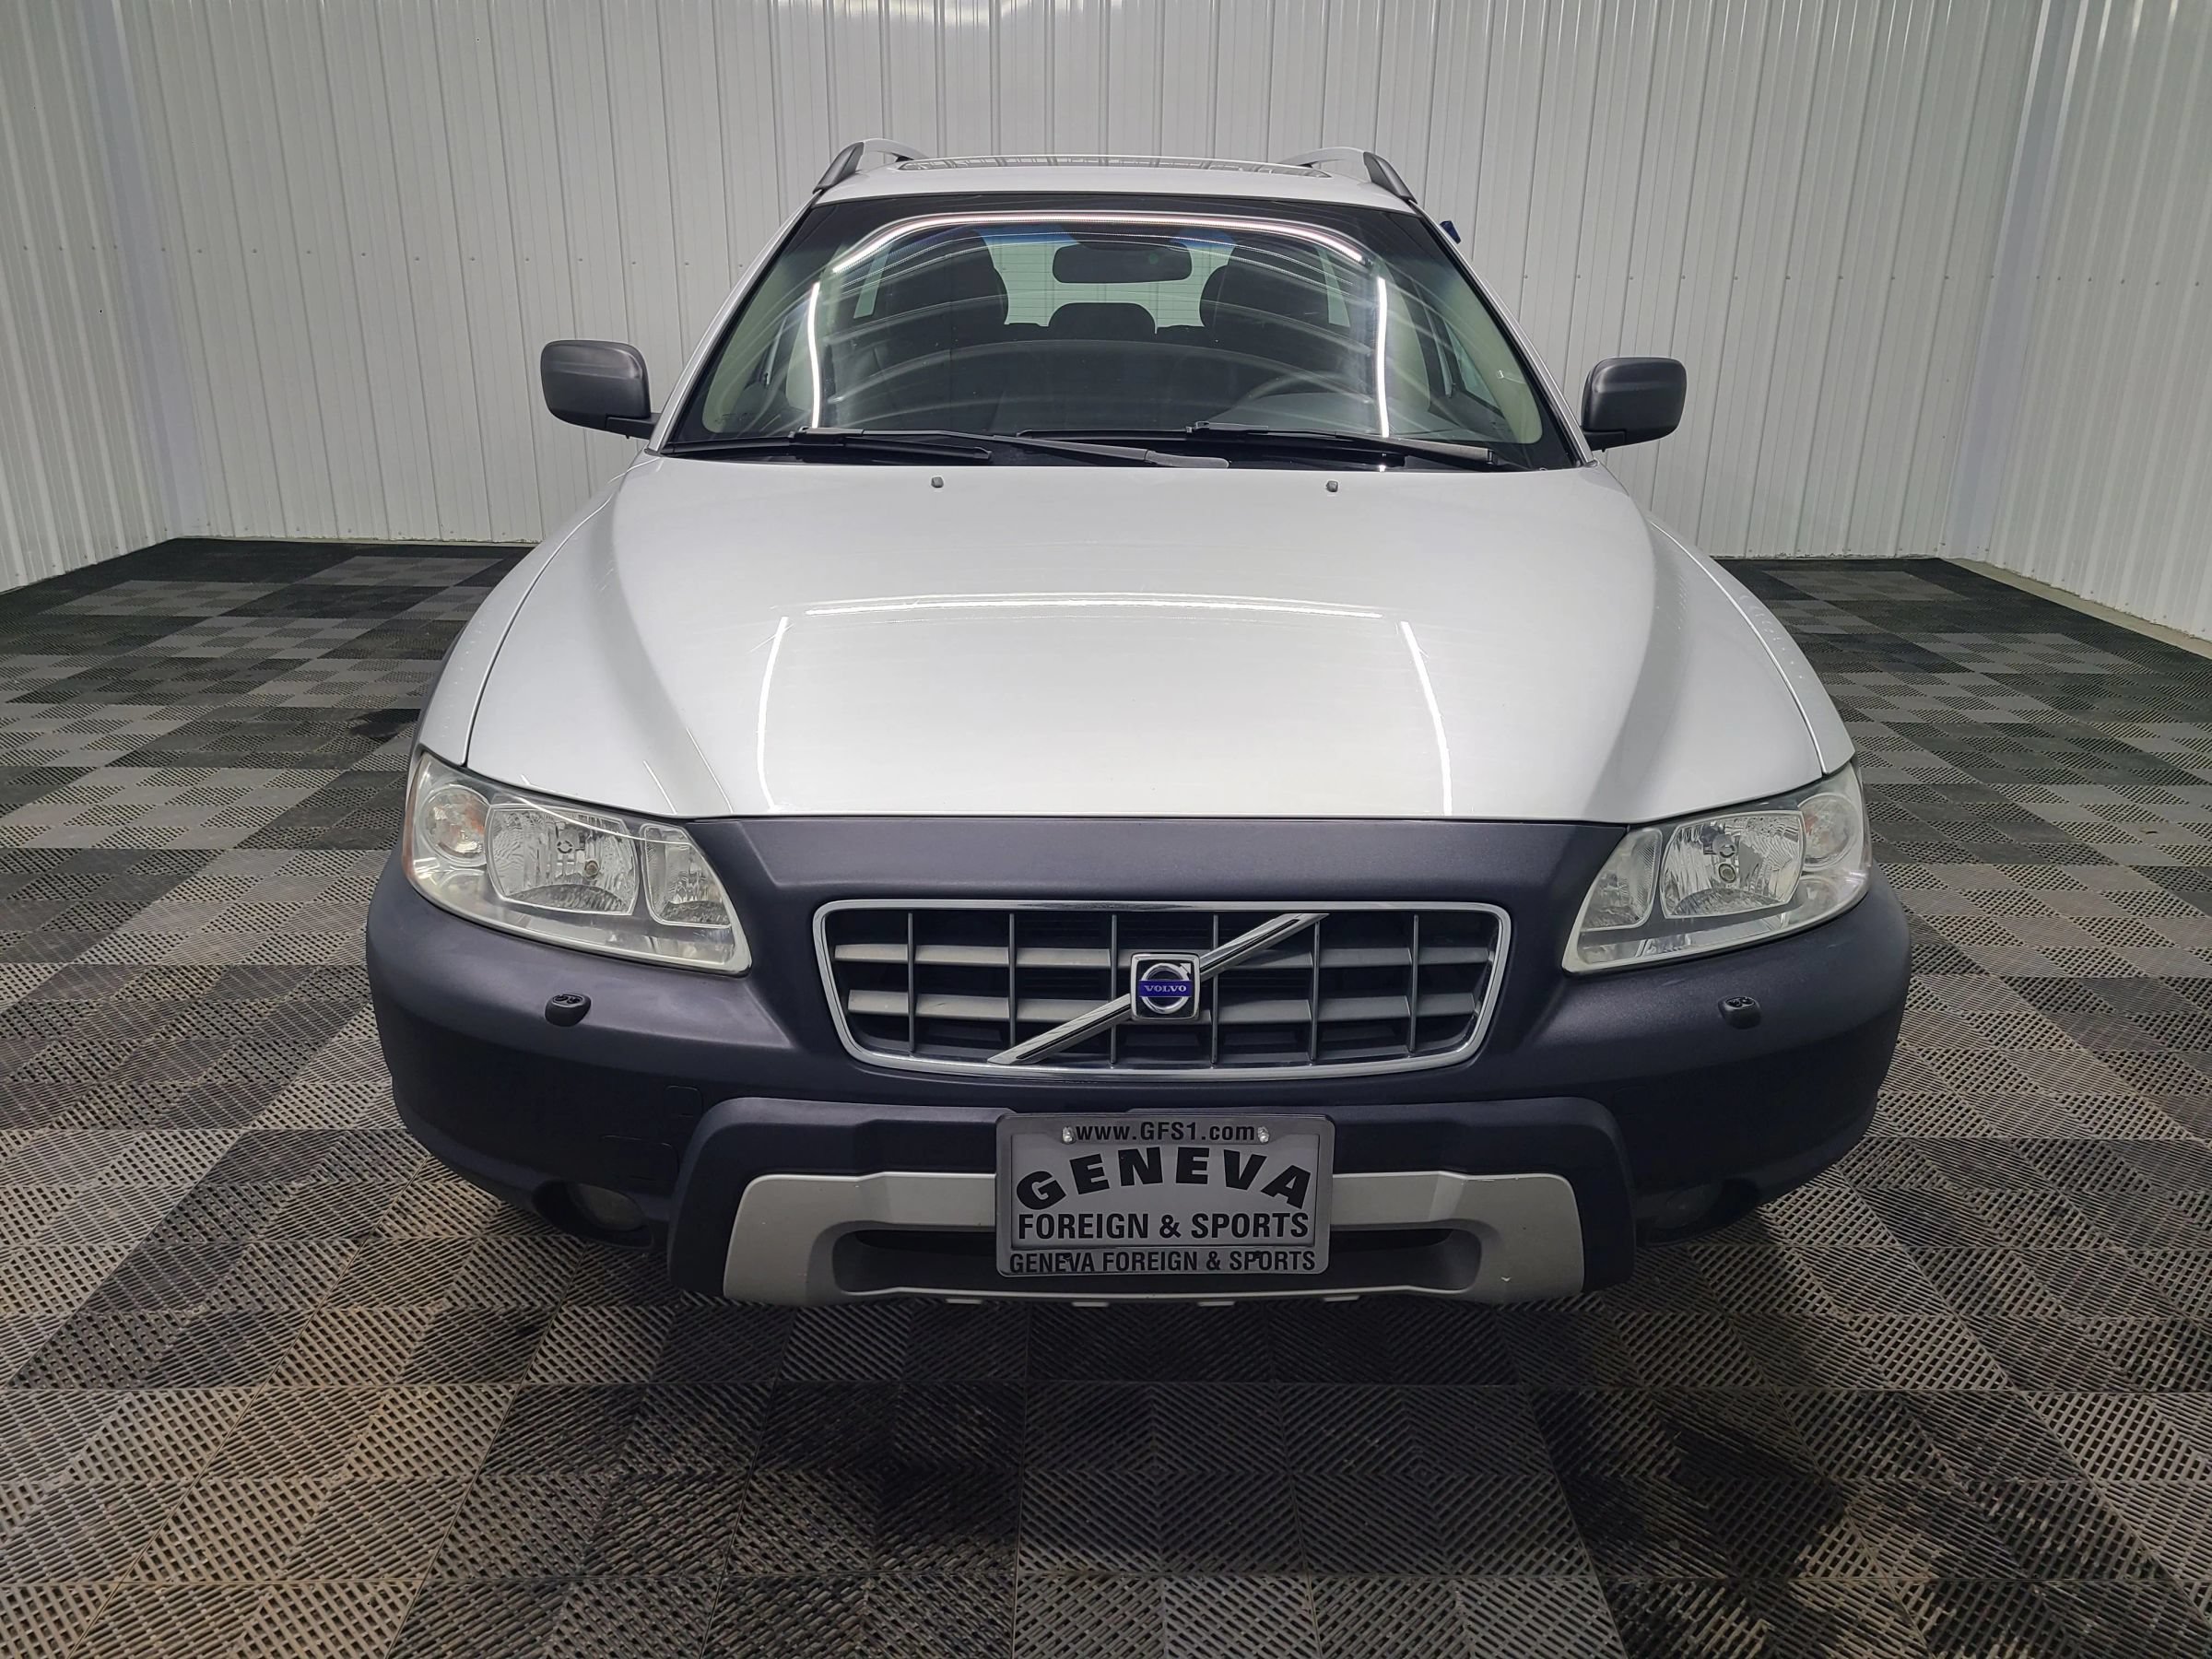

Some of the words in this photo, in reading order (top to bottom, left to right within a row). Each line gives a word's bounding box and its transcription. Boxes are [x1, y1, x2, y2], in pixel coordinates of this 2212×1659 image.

[1144, 984, 1187, 993] VOLVO
[1075, 1121, 1256, 1142] www.GFS1.com
[1016, 1146, 1312, 1210] GENEVA
[1018, 1213, 1149, 1240] FOREIGN
[1159, 1214, 1182, 1238] &
[1191, 1212, 1310, 1239] SPORTS
[1009, 1252, 1096, 1273] GENEVA
[1103, 1251, 1198, 1271] FOREIGN
[1206, 1251, 1221, 1271] &
[1229, 1249, 1315, 1271] SPORTS
